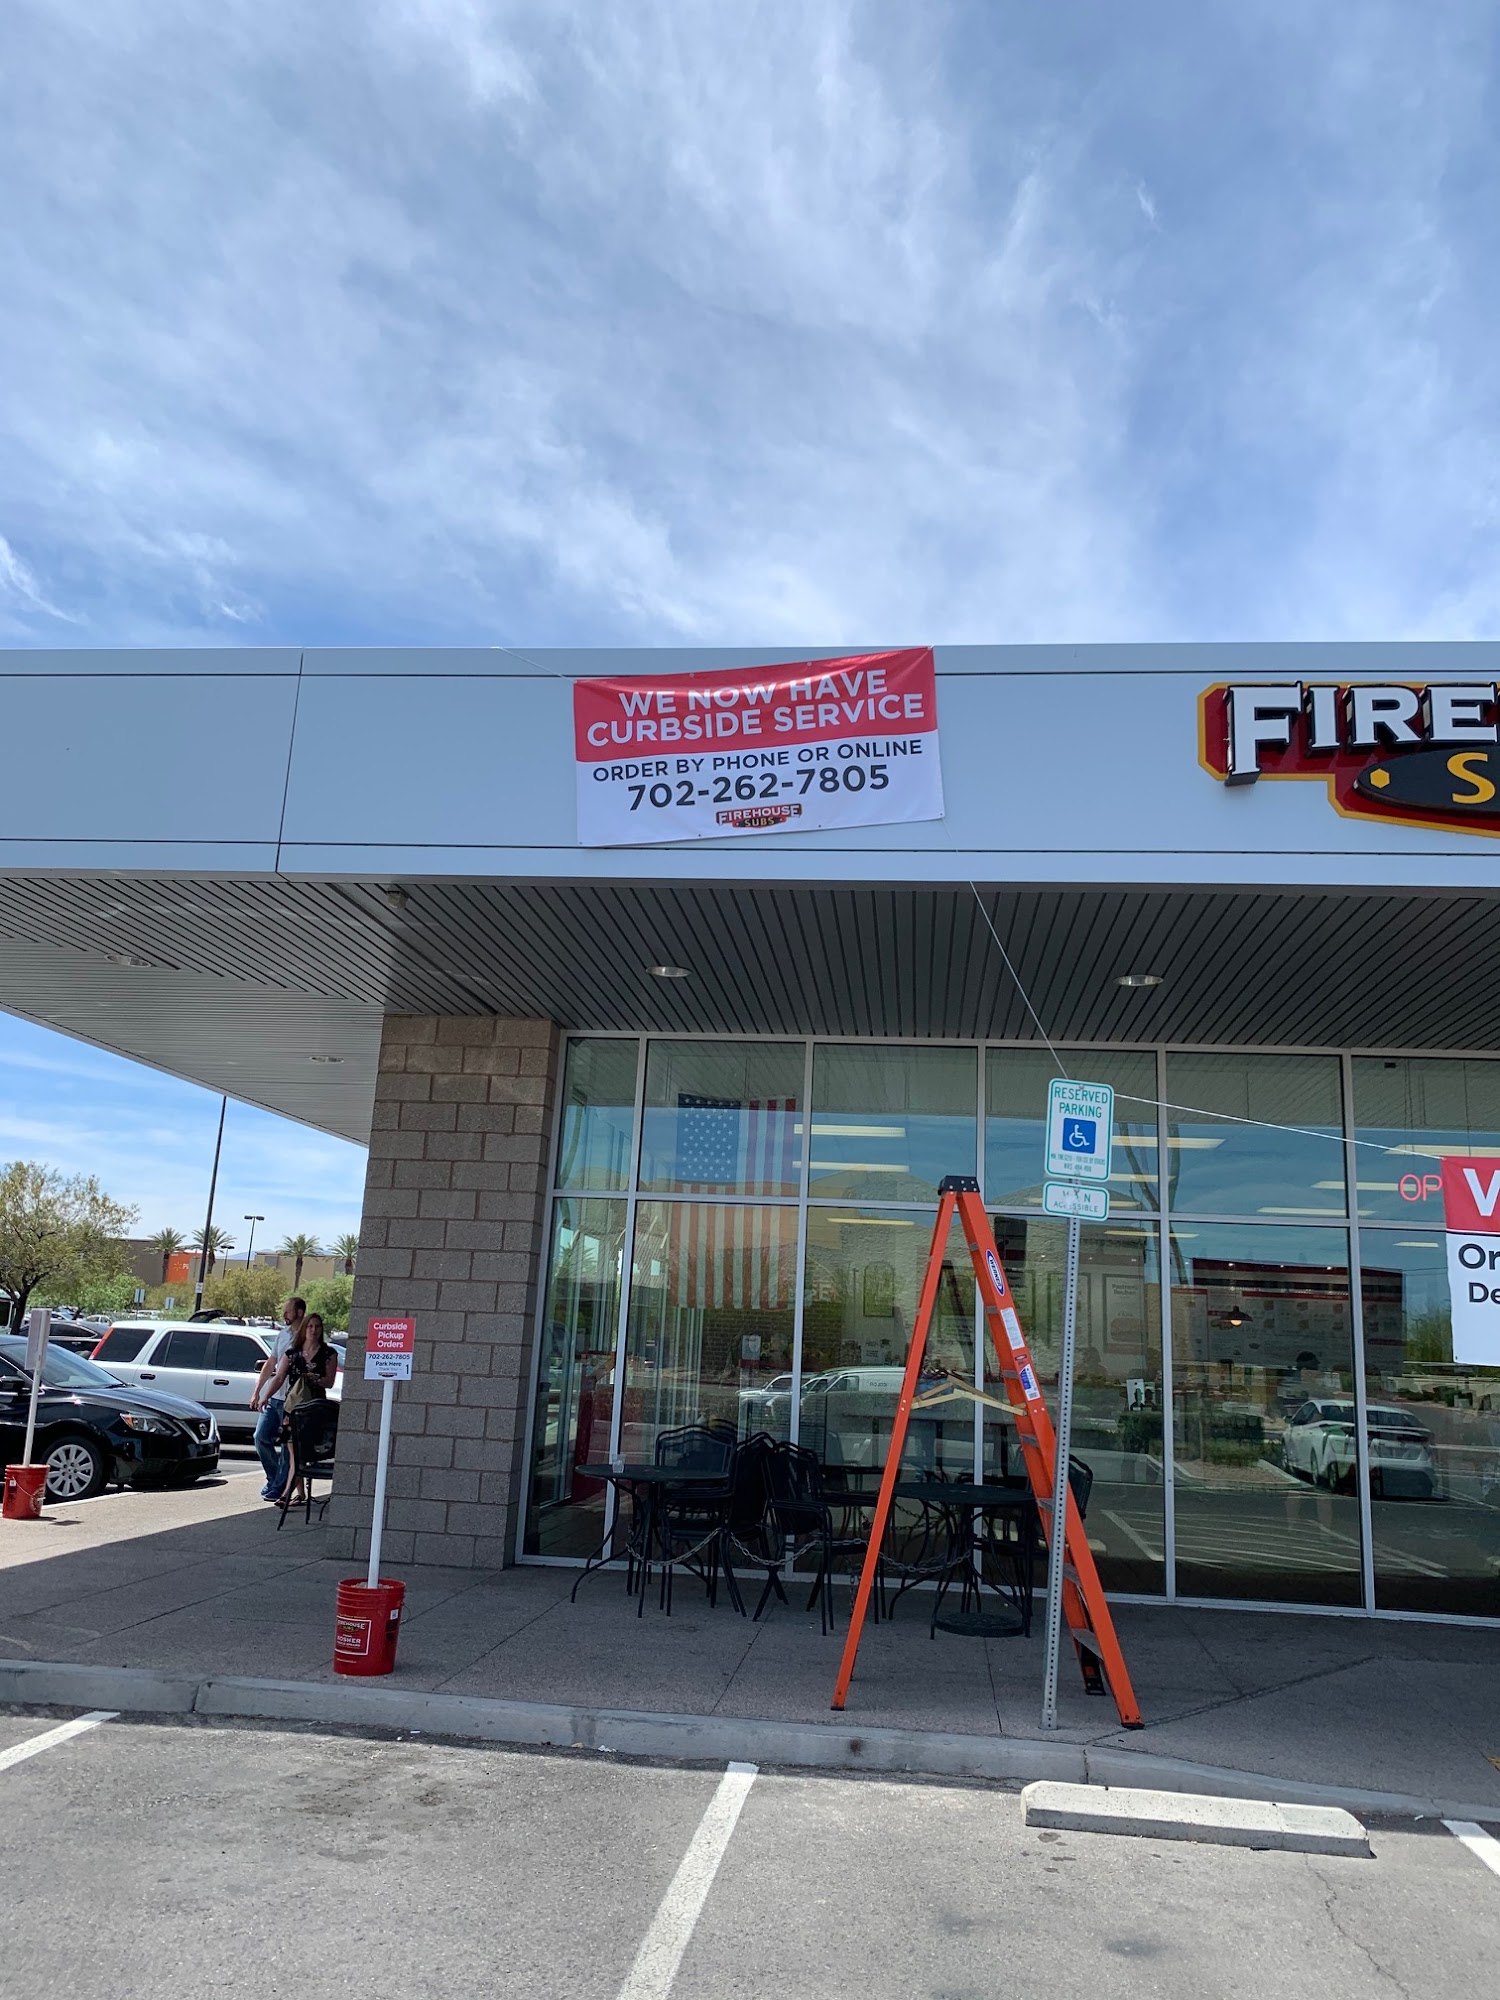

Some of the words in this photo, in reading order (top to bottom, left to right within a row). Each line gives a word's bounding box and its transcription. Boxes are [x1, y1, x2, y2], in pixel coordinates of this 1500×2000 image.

[618, 690, 676, 717] WE
[689, 681, 777, 709] NOW
[790, 669, 888, 701] HAVE
[586, 708, 762, 747] CURBSIDE
[774, 692, 925, 733] SERVICE
[1228, 684, 1498, 777] FIRE
[593, 761, 668, 783] ORDER
[677, 757, 705, 773] BY
[713, 750, 790, 770] PHONE
[798, 747, 829, 763] OR
[837, 739, 923, 759] ONLINE
[628, 764, 890, 811] 702-262-7805
[1446, 752, 1496, 804] S
[718, 805, 800, 826] FIREHOUSE
[744, 816, 775, 827] SUBS
[1054, 1086, 1108, 1104] RESERVED
[1058, 1102, 1102, 1118] PARKING
[990, 1260, 1002, 1287] WERNER
[378, 1332, 404, 1340] Pickup
[406, 1364, 409, 1375] 1
